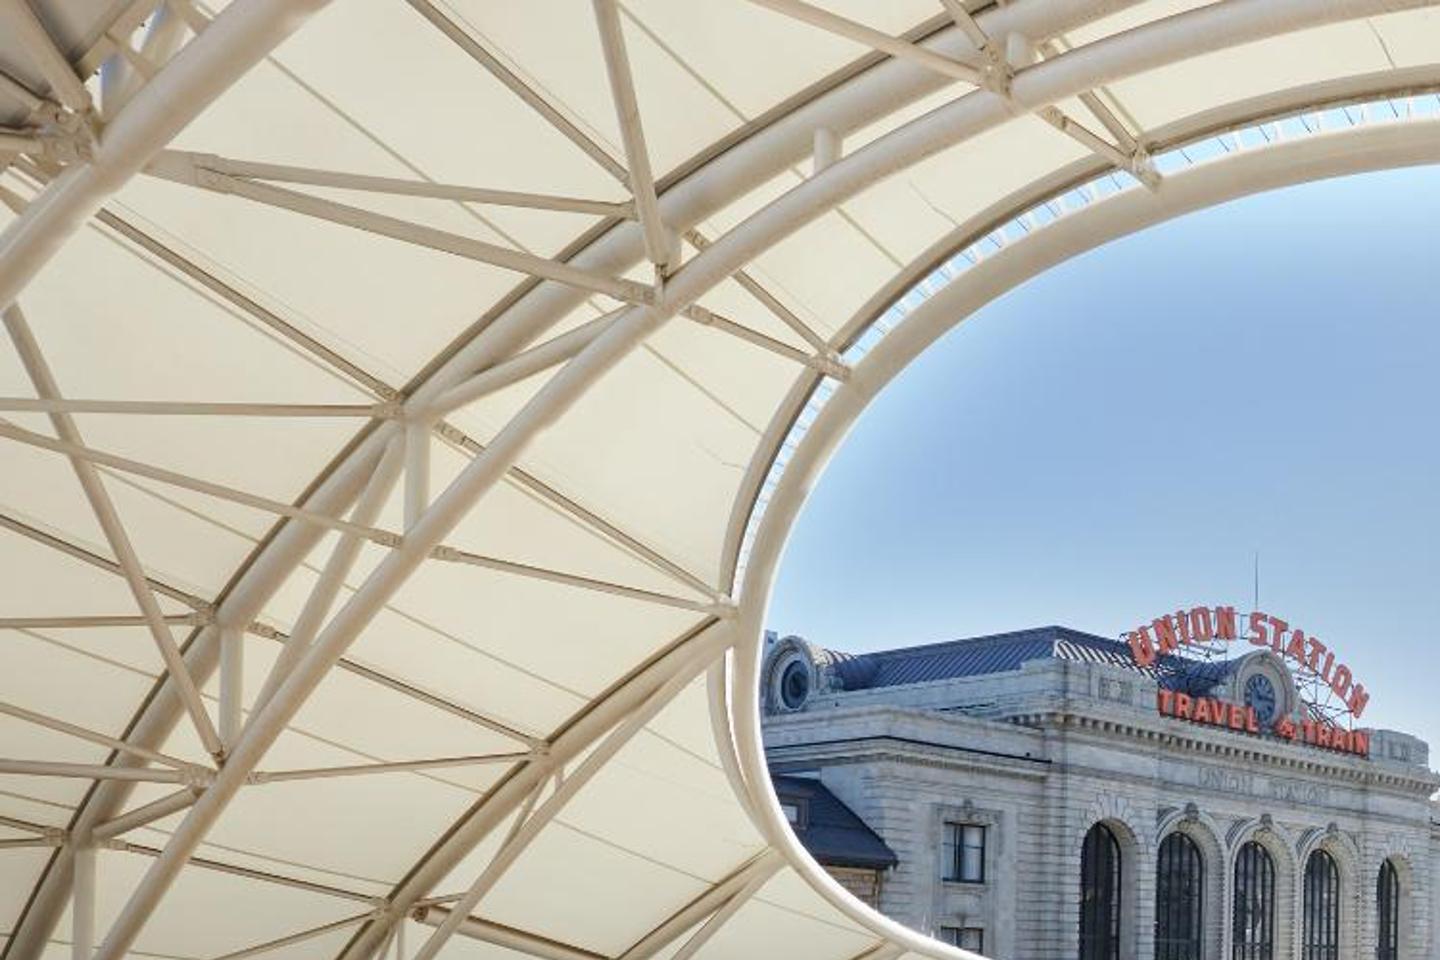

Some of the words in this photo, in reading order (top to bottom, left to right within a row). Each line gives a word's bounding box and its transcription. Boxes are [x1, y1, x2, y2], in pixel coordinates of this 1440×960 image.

[1127, 605, 1236, 668] UNION
[1249, 611, 1370, 719] STATION
[1157, 687, 1260, 733] TRAVEL
[1301, 717, 1370, 759] TRAIN
